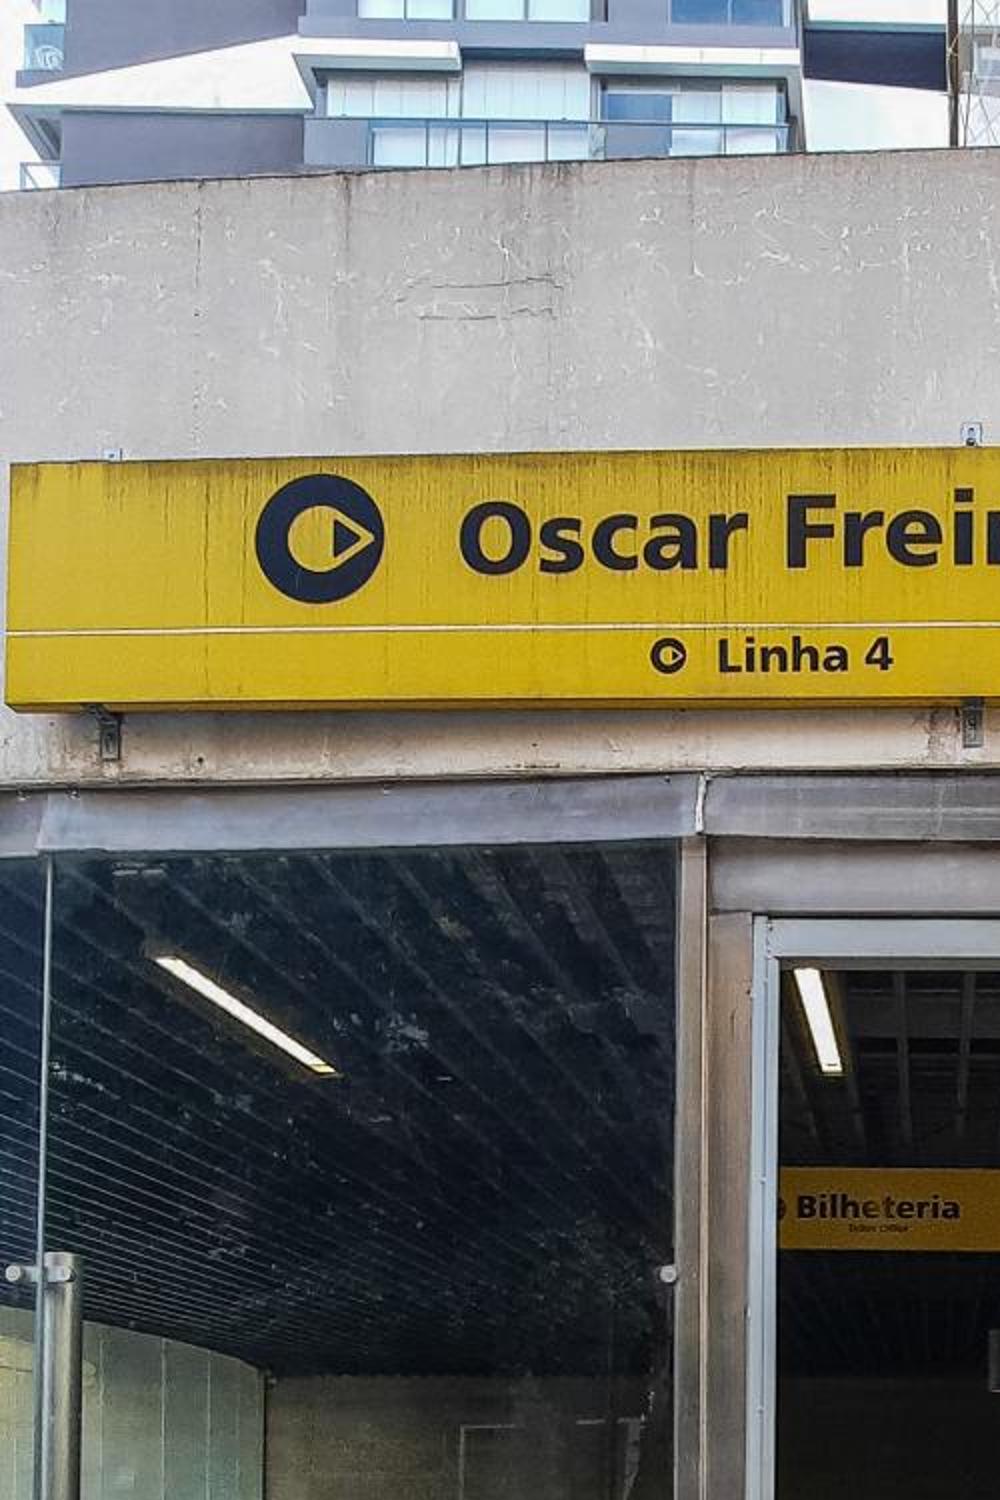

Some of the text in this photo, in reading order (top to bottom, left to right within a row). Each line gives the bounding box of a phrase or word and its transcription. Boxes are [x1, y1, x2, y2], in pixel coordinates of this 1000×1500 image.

[459, 500, 748, 574] Oscar
[718, 636, 893, 674] Linha 4
[797, 1193, 961, 1219] Bilheteria
